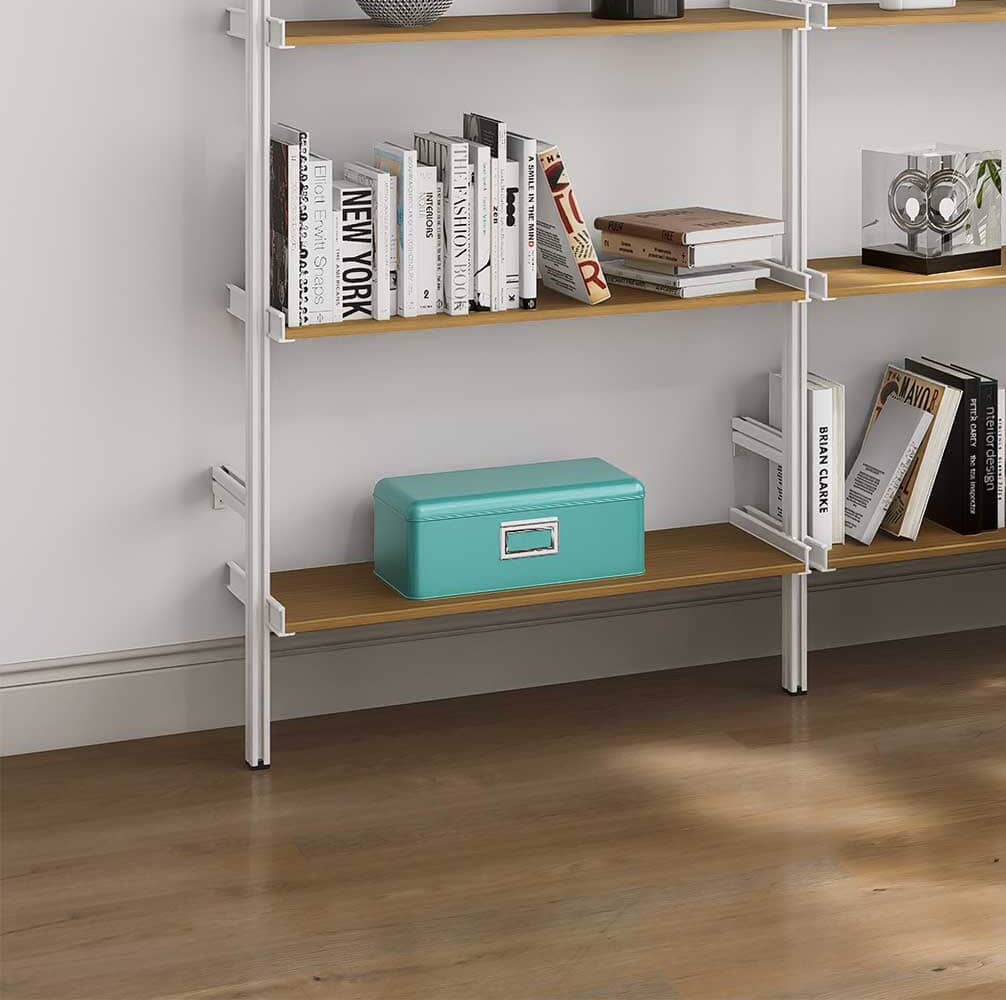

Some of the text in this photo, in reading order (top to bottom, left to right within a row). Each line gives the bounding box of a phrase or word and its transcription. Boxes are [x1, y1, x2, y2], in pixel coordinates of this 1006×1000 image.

[528, 155, 535, 163] A
[425, 192, 434, 239] INTERIORS
[528, 193, 535, 203] IN
[313, 209, 328, 251] Erwitt
[453, 144, 468, 311] THE FASHION BOOK
[342, 190, 372, 319] NEW YORK
[310, 255, 328, 305] Snaps
[423, 289, 430, 300] 2
[969, 398, 977, 422] PETER
[969, 423, 977, 448] CAREY
[819, 426, 829, 514] BRIAN CLARKE
[969, 454, 977, 467] the
[983, 449, 996, 492] design
